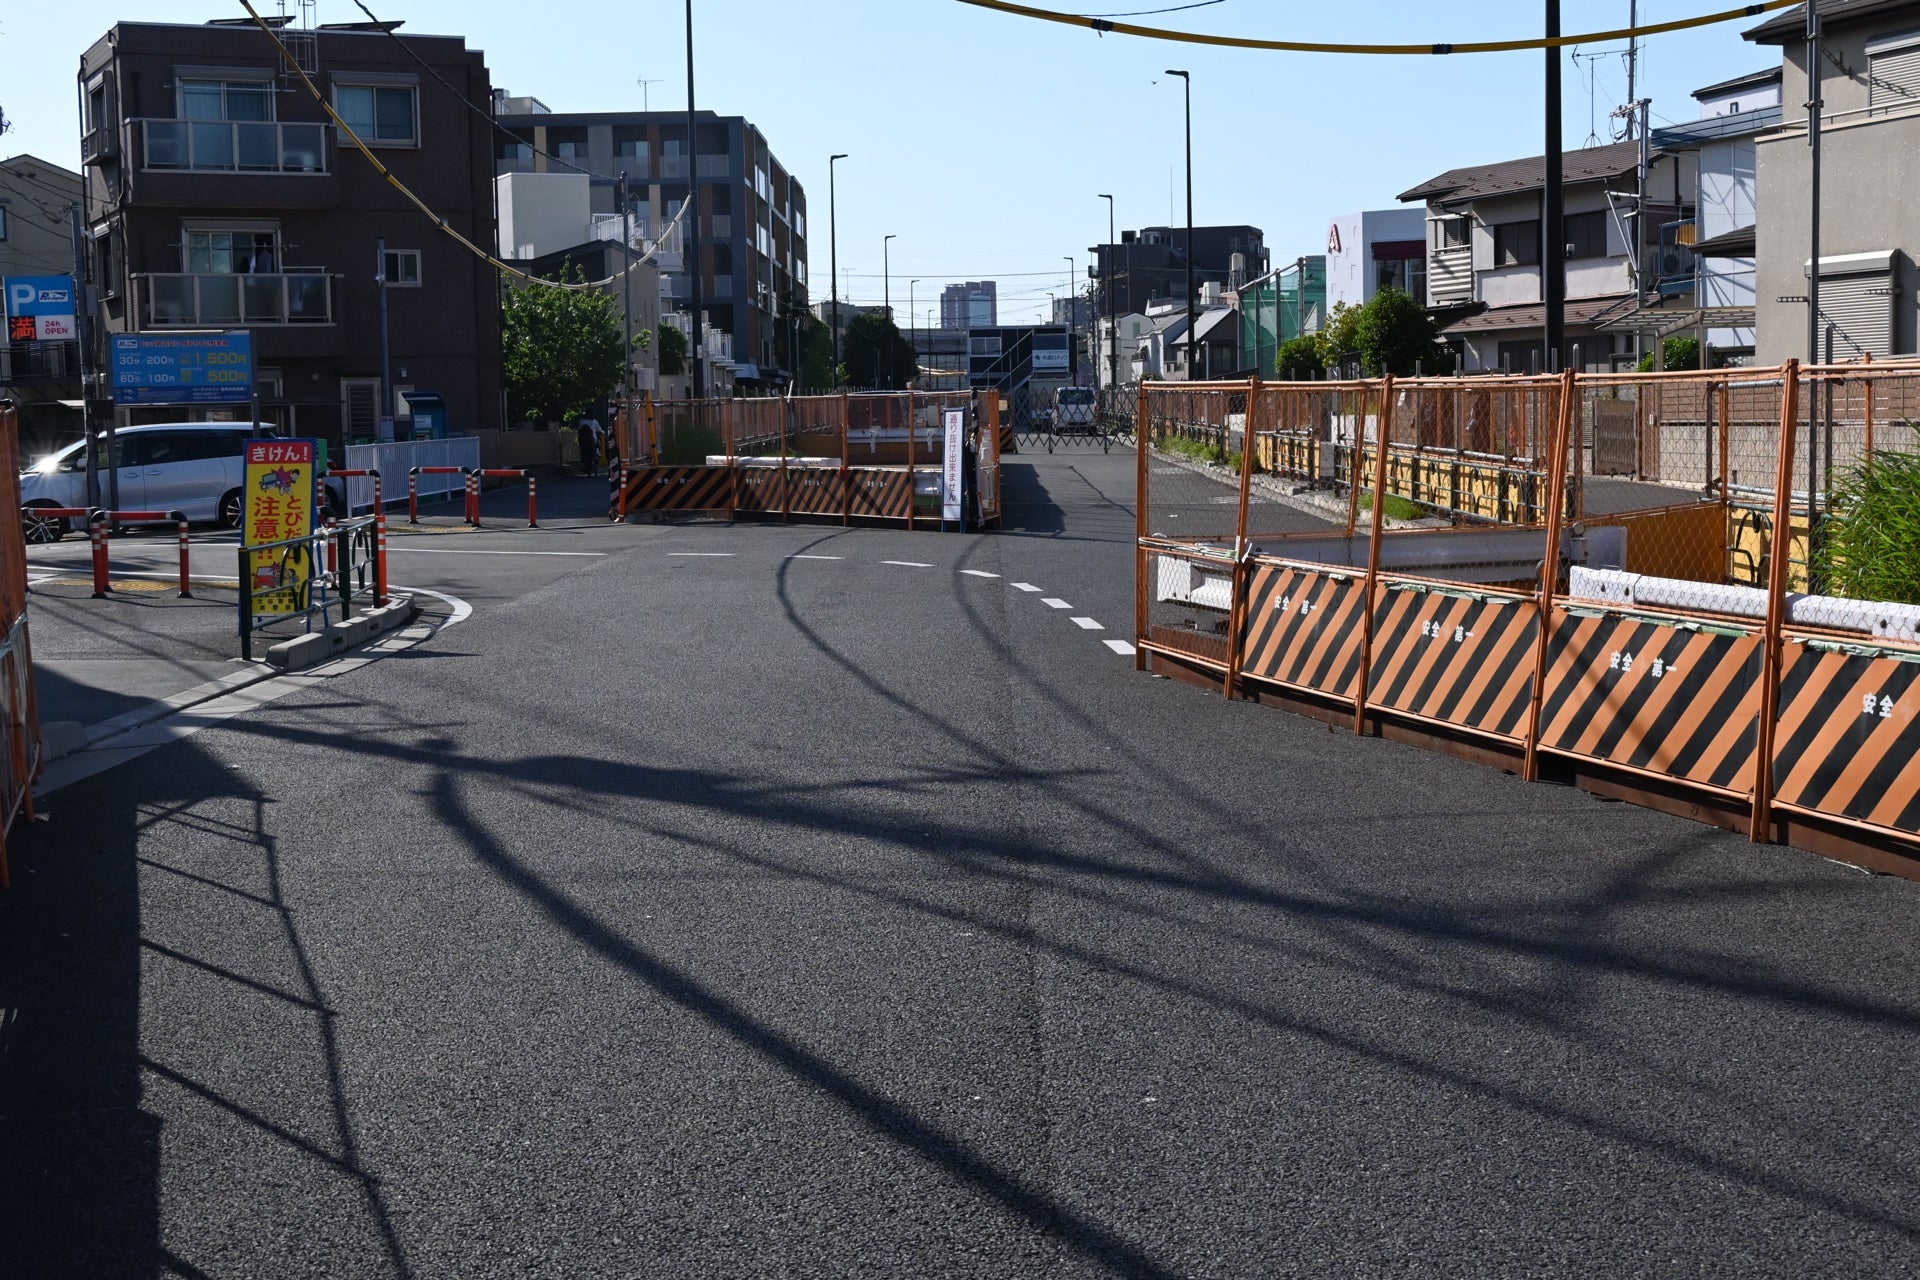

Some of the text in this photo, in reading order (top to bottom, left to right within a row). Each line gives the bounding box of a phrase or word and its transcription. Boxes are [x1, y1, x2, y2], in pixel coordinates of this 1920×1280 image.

[11, 285, 35, 316] P
[11, 317, 35, 339] 満
[253, 446, 308, 461] きけん!
[949, 414, 957, 501] 通り抜け出来ません
[1862, 692, 1894, 718] 安全
